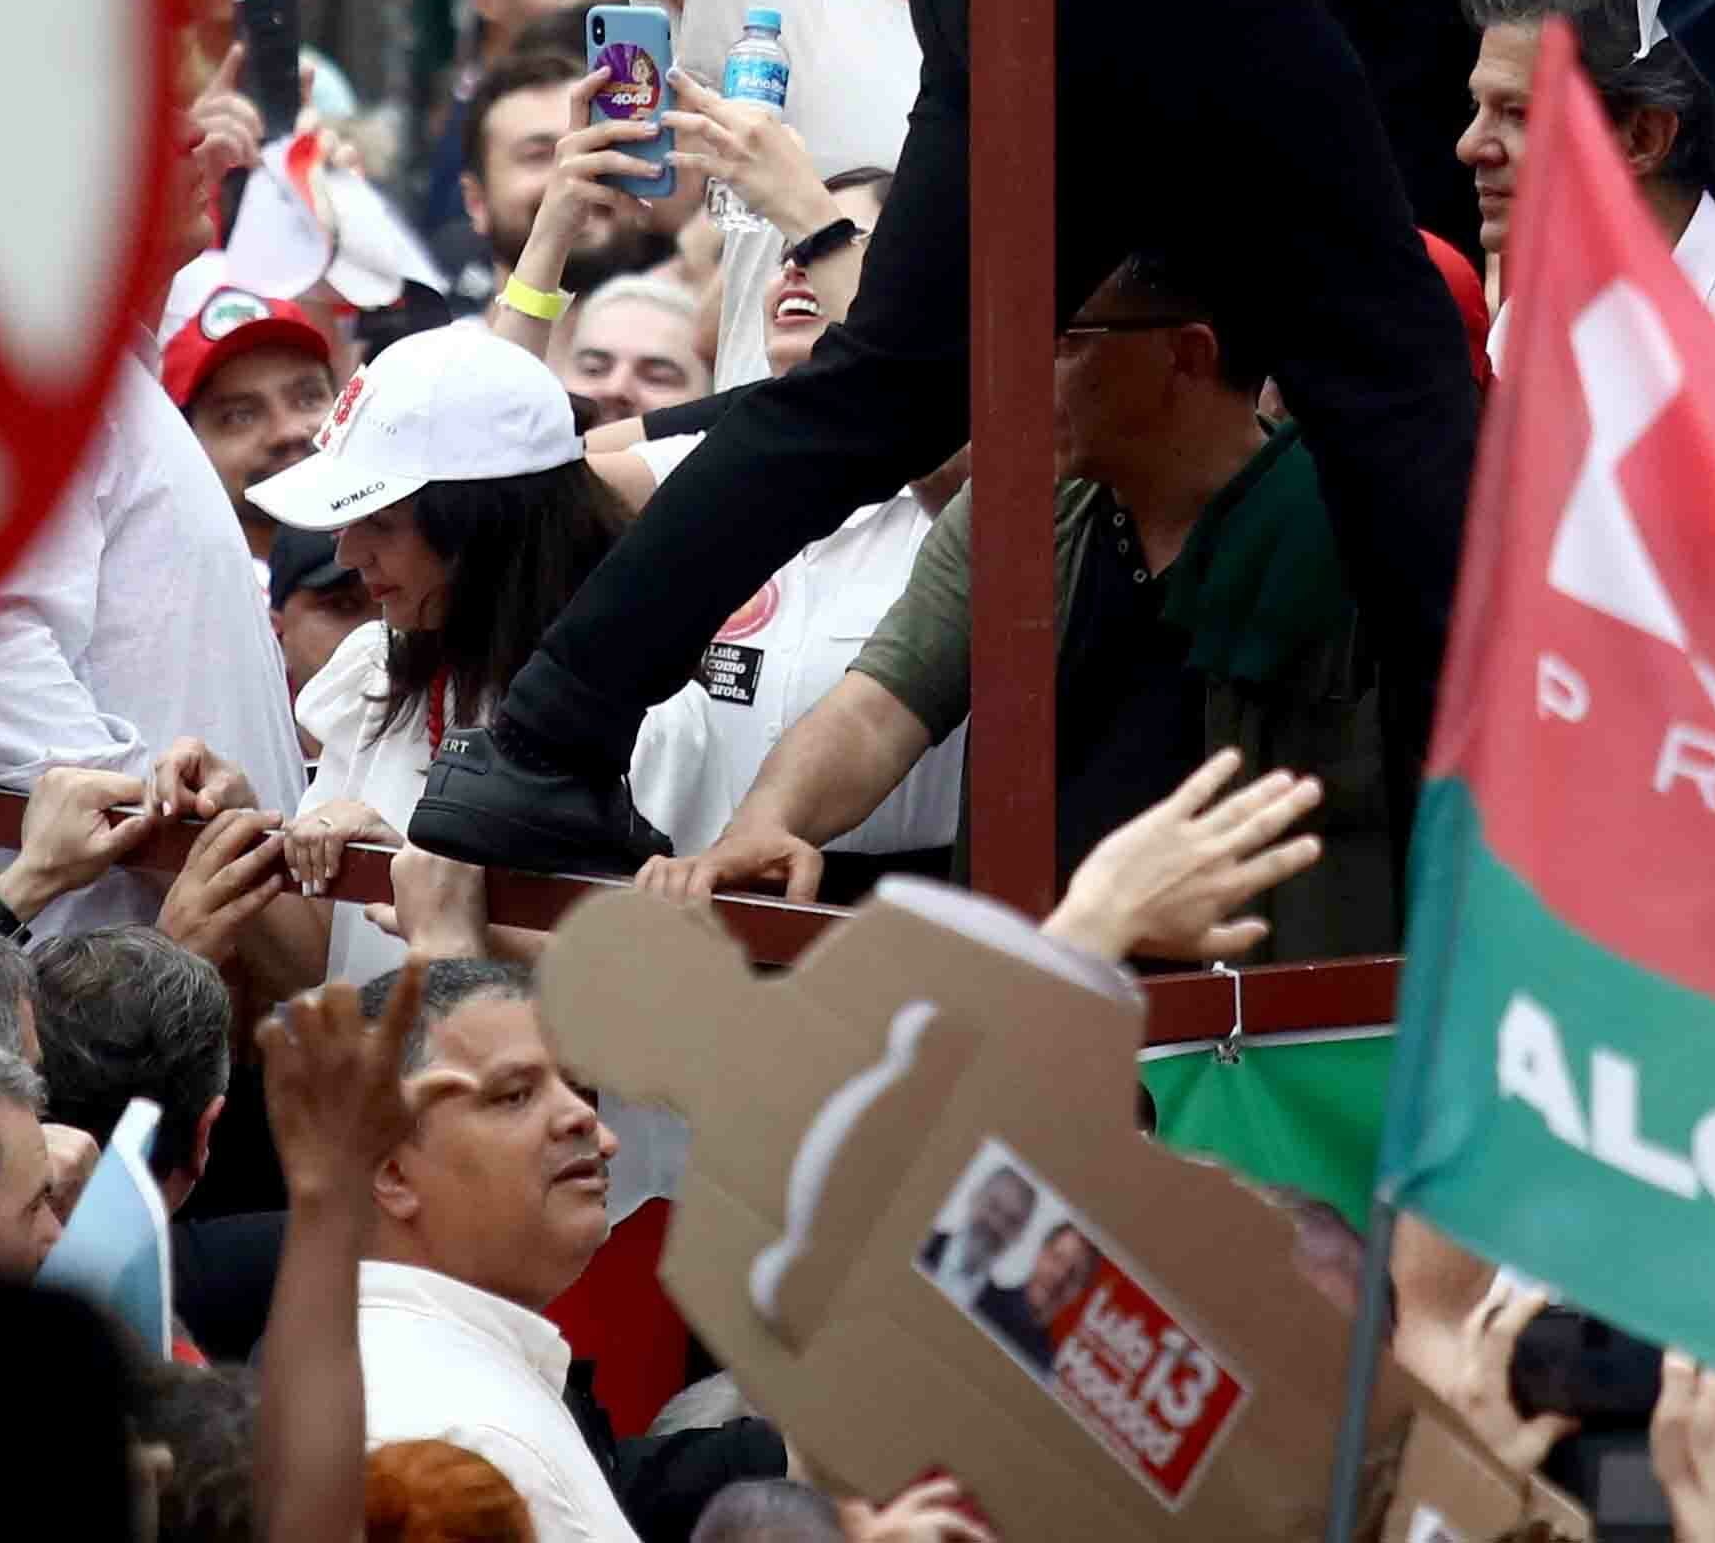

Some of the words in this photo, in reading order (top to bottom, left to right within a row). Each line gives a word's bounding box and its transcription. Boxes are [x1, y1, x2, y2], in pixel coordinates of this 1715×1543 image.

[610, 91, 653, 106] 4040
[330, 480, 386, 511] MONACO
[708, 644, 741, 661] Lute
[707, 658, 747, 675] como
[708, 682, 750, 701] arota.
[1083, 1286, 1155, 1372] Lula
[1143, 1324, 1219, 1429] 13
[1053, 1334, 1183, 1466] Haddad
